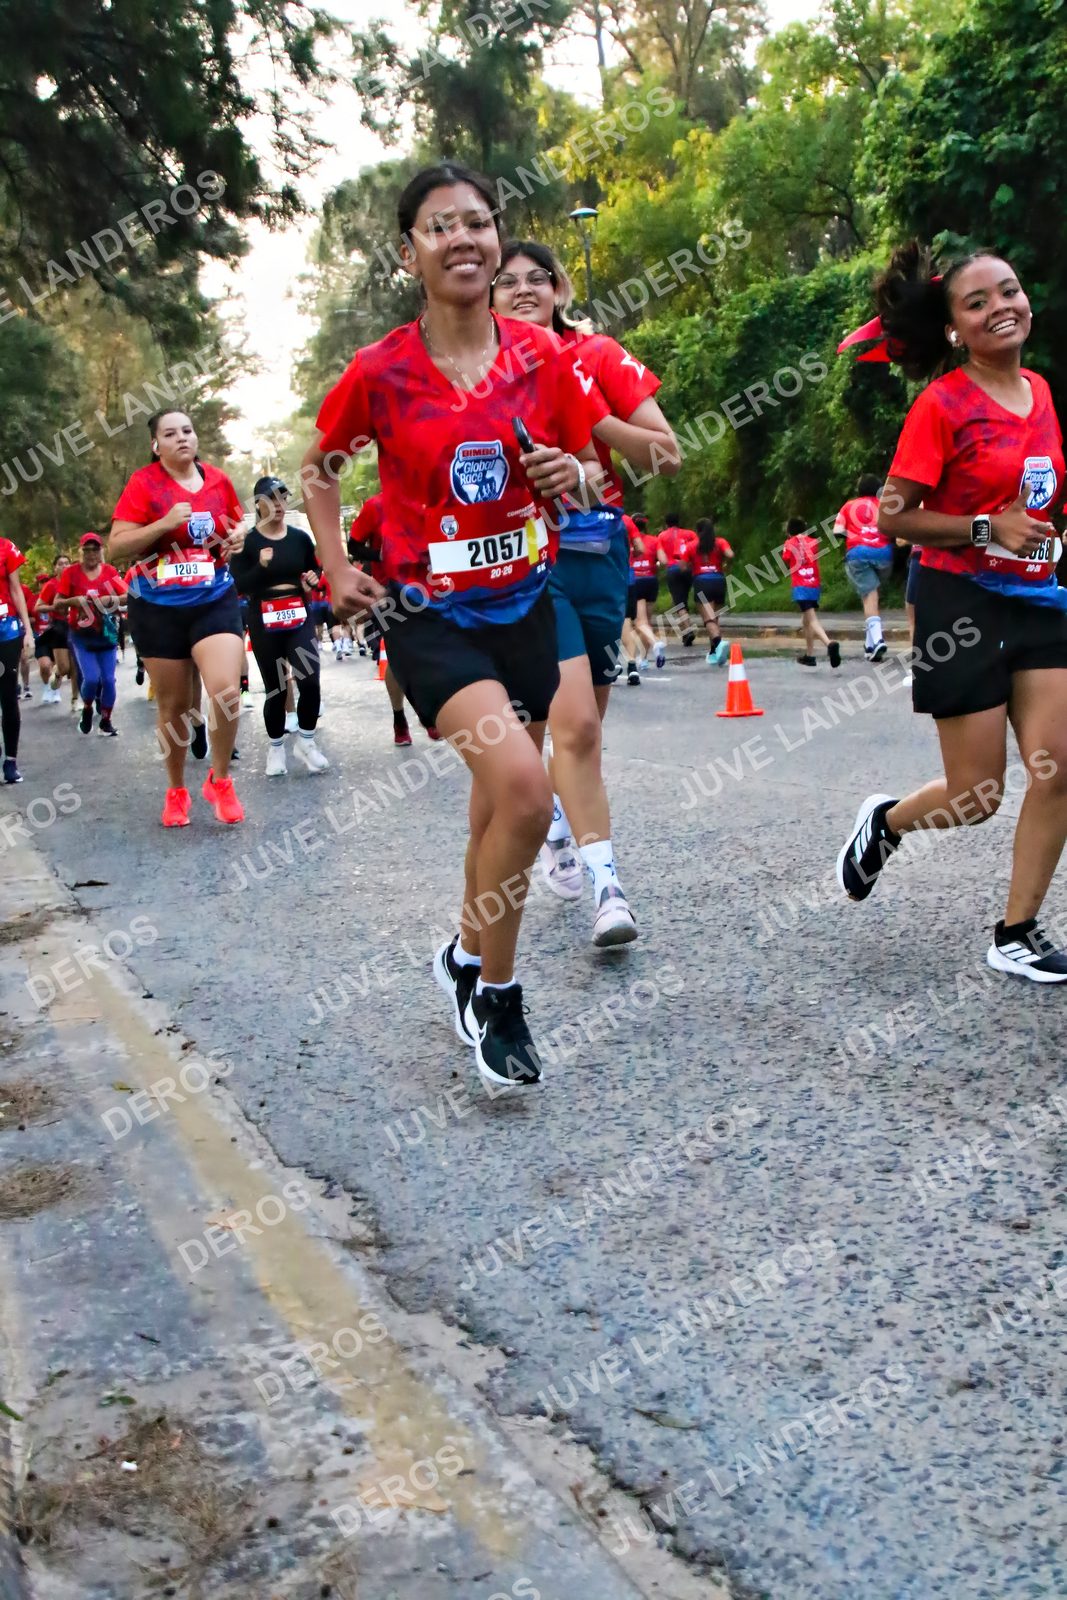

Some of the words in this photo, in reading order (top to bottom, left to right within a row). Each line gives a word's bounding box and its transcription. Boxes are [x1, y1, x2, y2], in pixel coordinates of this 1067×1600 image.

[461, 447, 497, 458] BIMBO
[463, 459, 495, 474] Global
[460, 471, 483, 486] Race
[467, 530, 523, 568] 2057
[1017, 539, 1051, 560] 68
[174, 563, 198, 576] 1203
